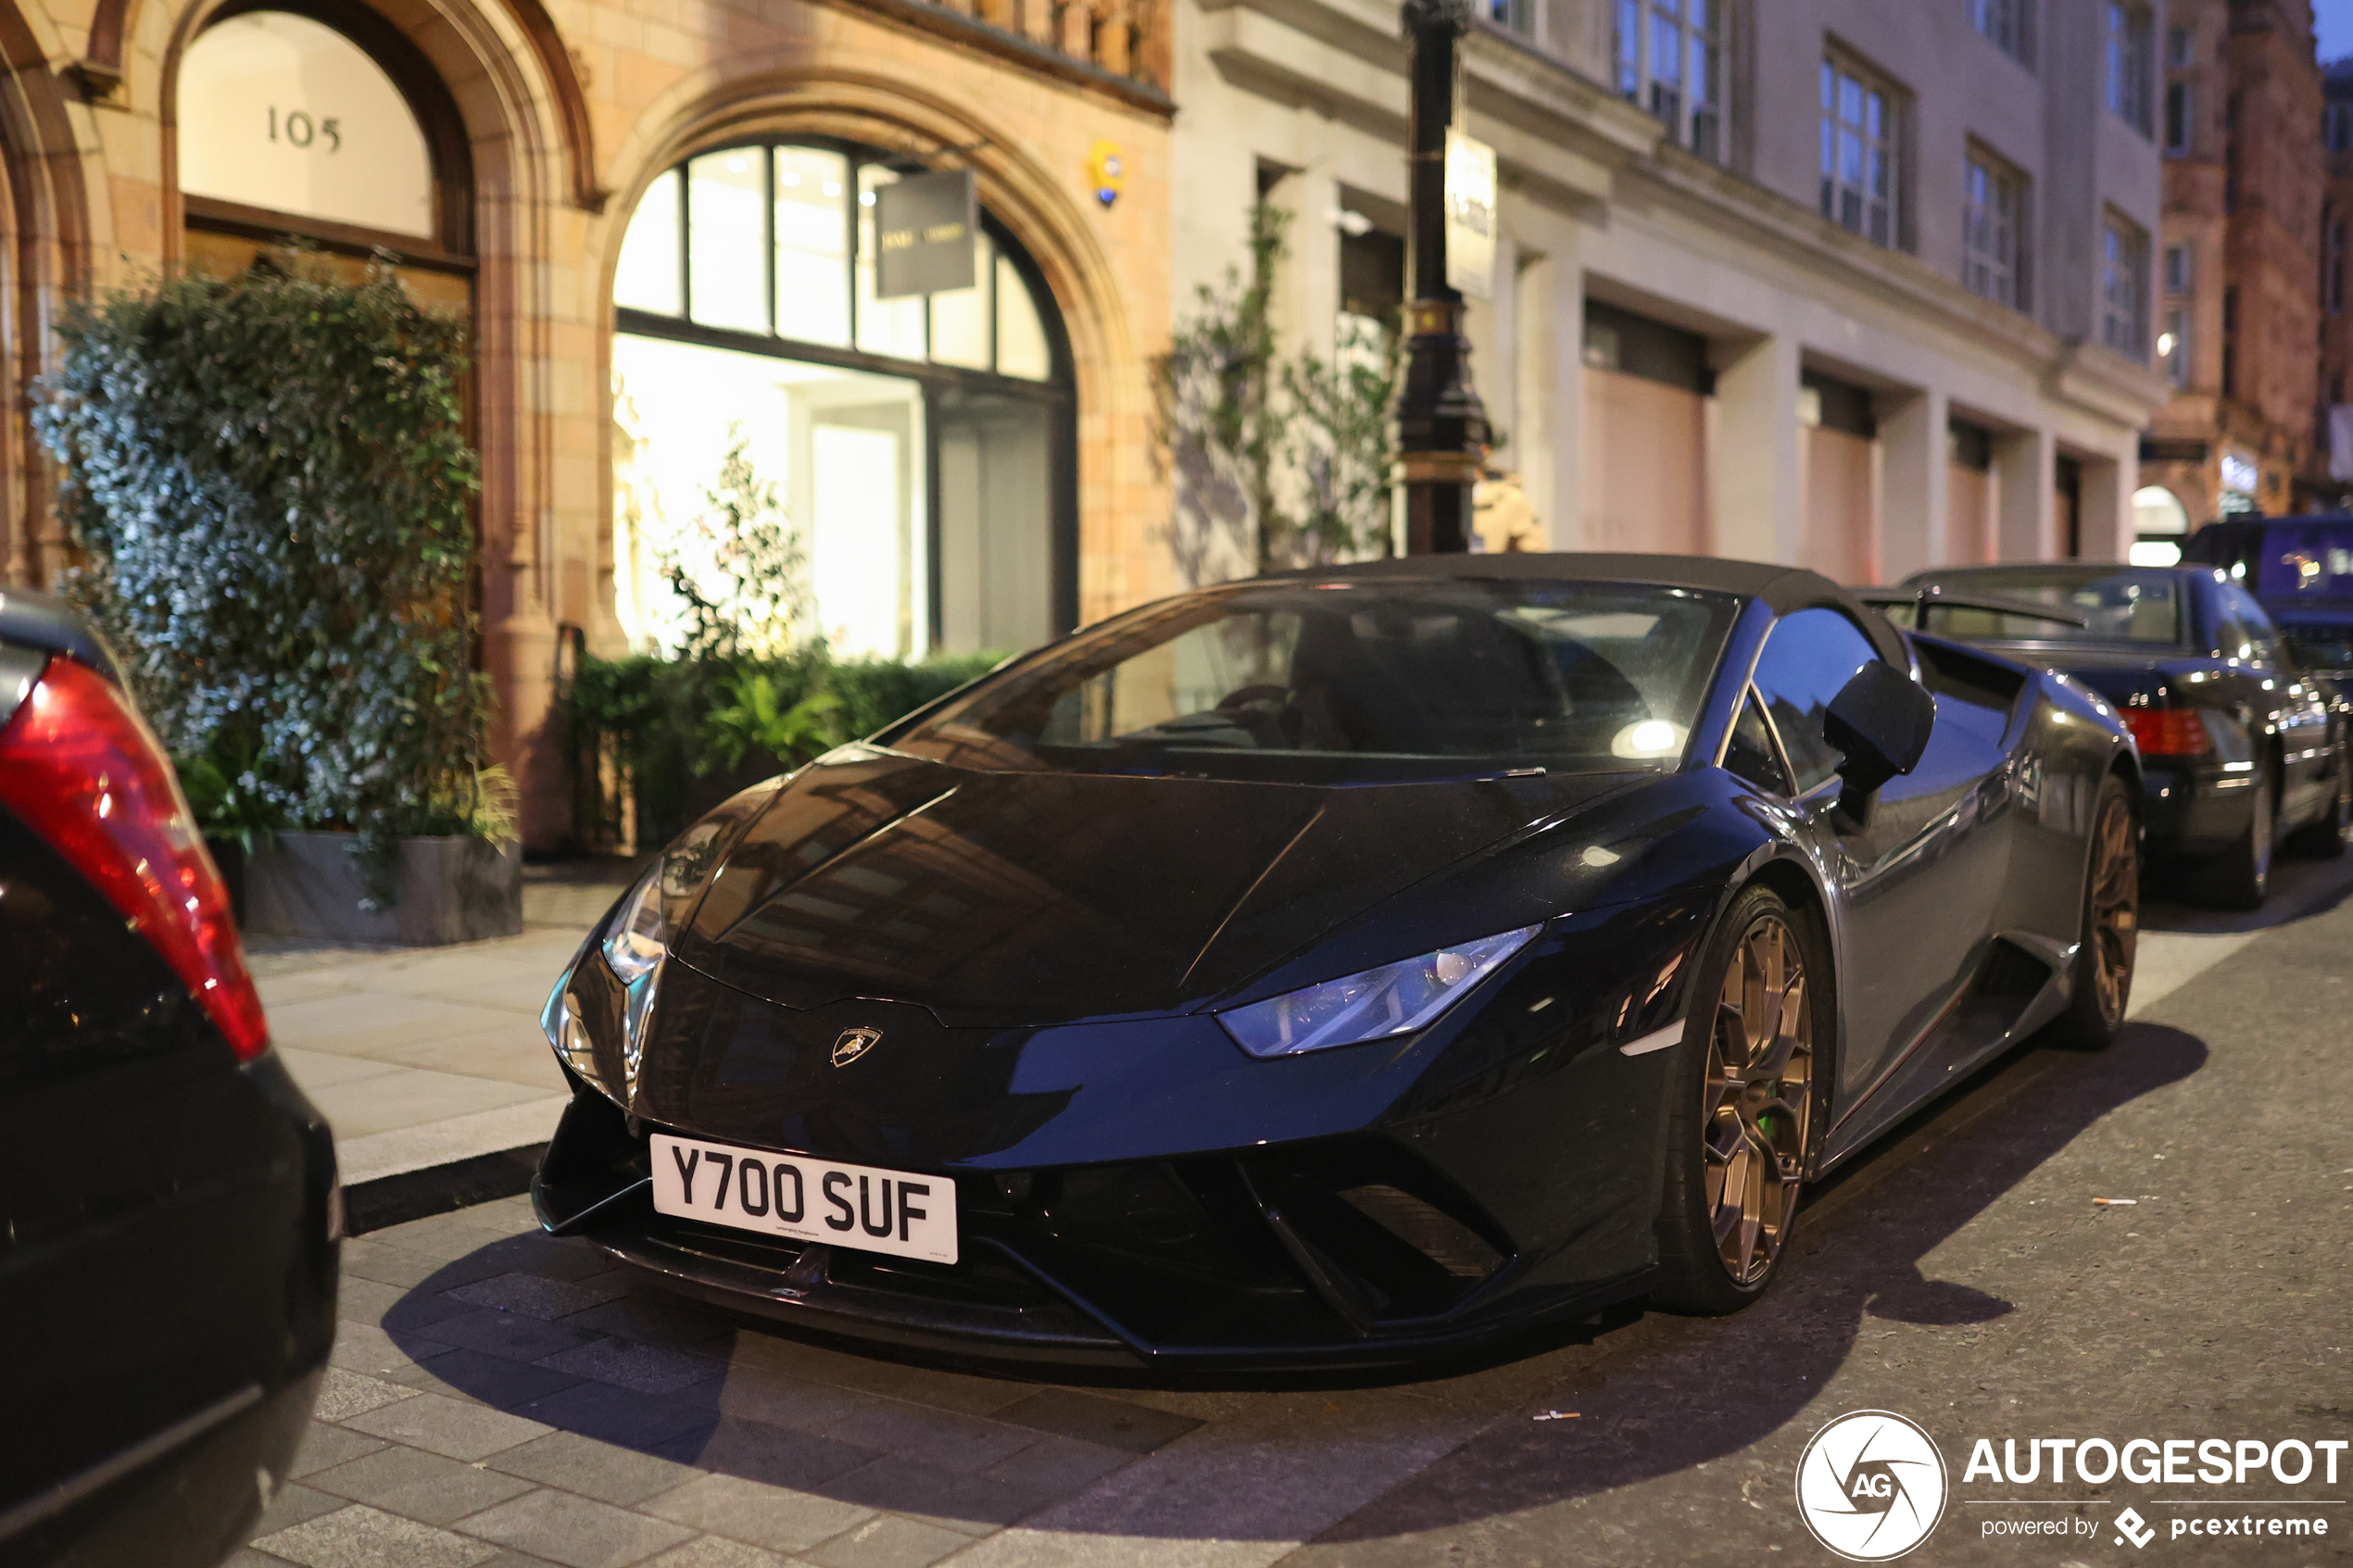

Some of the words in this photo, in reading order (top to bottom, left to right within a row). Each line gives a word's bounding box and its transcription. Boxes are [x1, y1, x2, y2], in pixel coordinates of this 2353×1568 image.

[269, 107, 341, 153] 105
[673, 1146, 804, 1223] Y700
[823, 1172, 929, 1241] SUF
